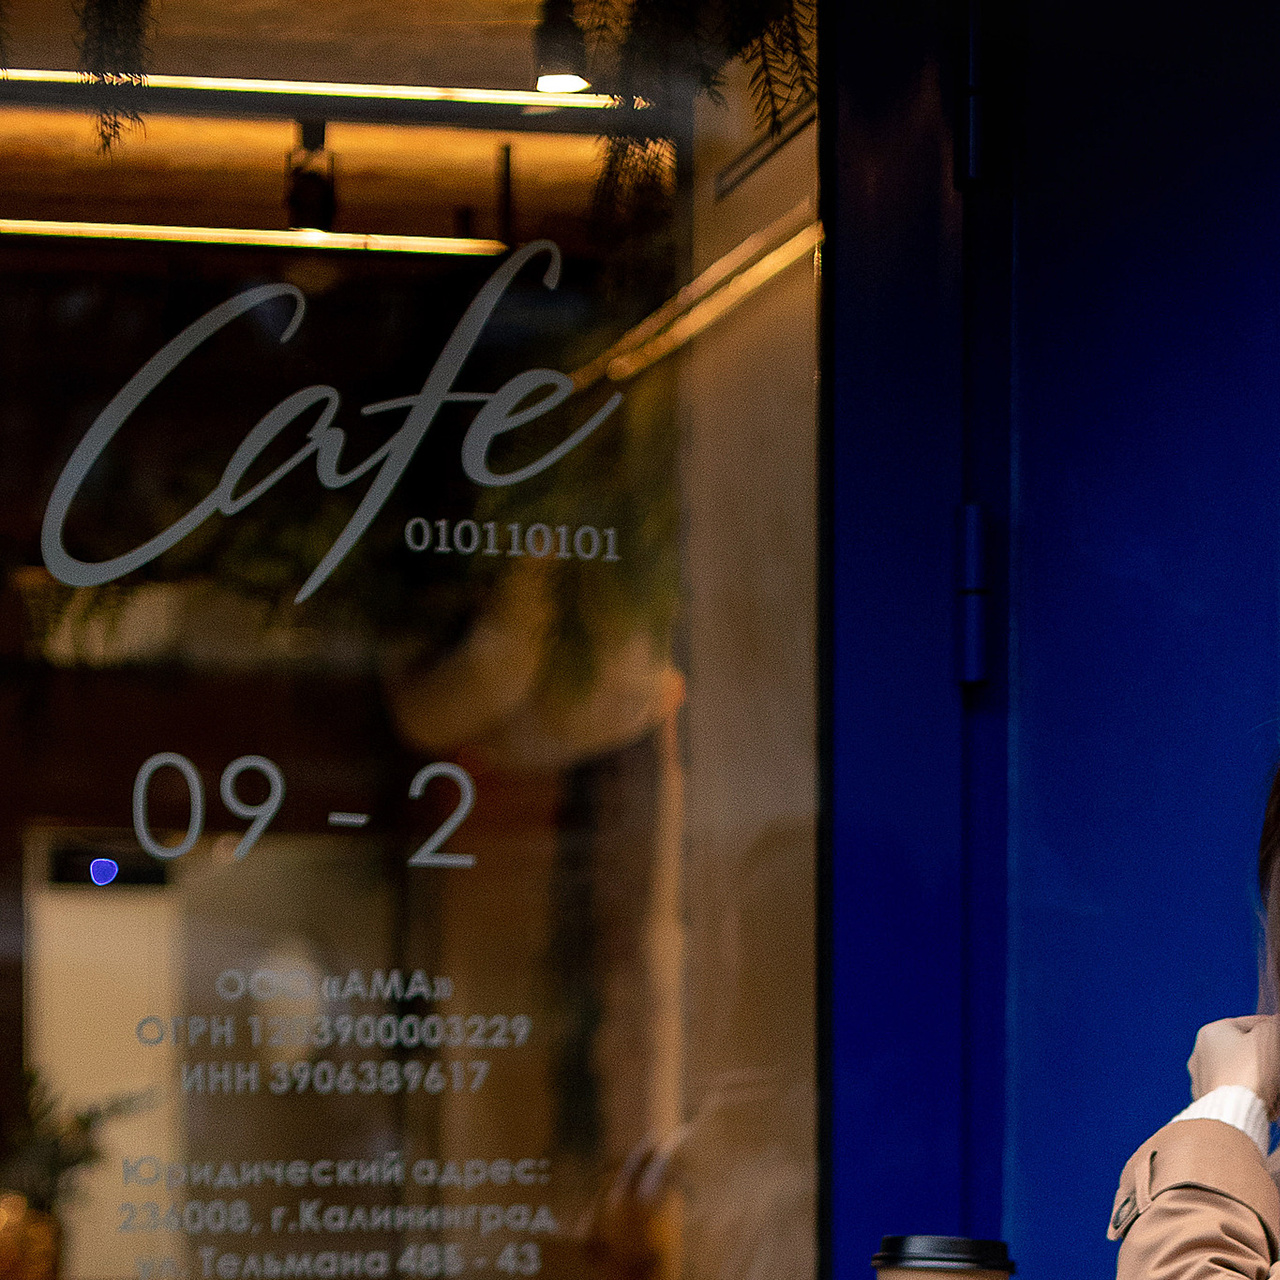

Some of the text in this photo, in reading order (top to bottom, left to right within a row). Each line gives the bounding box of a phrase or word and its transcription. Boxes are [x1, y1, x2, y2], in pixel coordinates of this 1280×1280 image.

[40, 239, 622, 606] Cafe
[404, 516, 621, 562] 010110101
[132, 752, 286, 861] 09
[406, 761, 477, 868] 2
[216, 969, 314, 1001] ООО
[134, 1014, 234, 1047] ОГРН
[180, 1060, 491, 1095] ИНН 3906389617
[121, 1152, 551, 1193] Юридический адрес:
[198, 1245, 390, 1280] Тельмана
